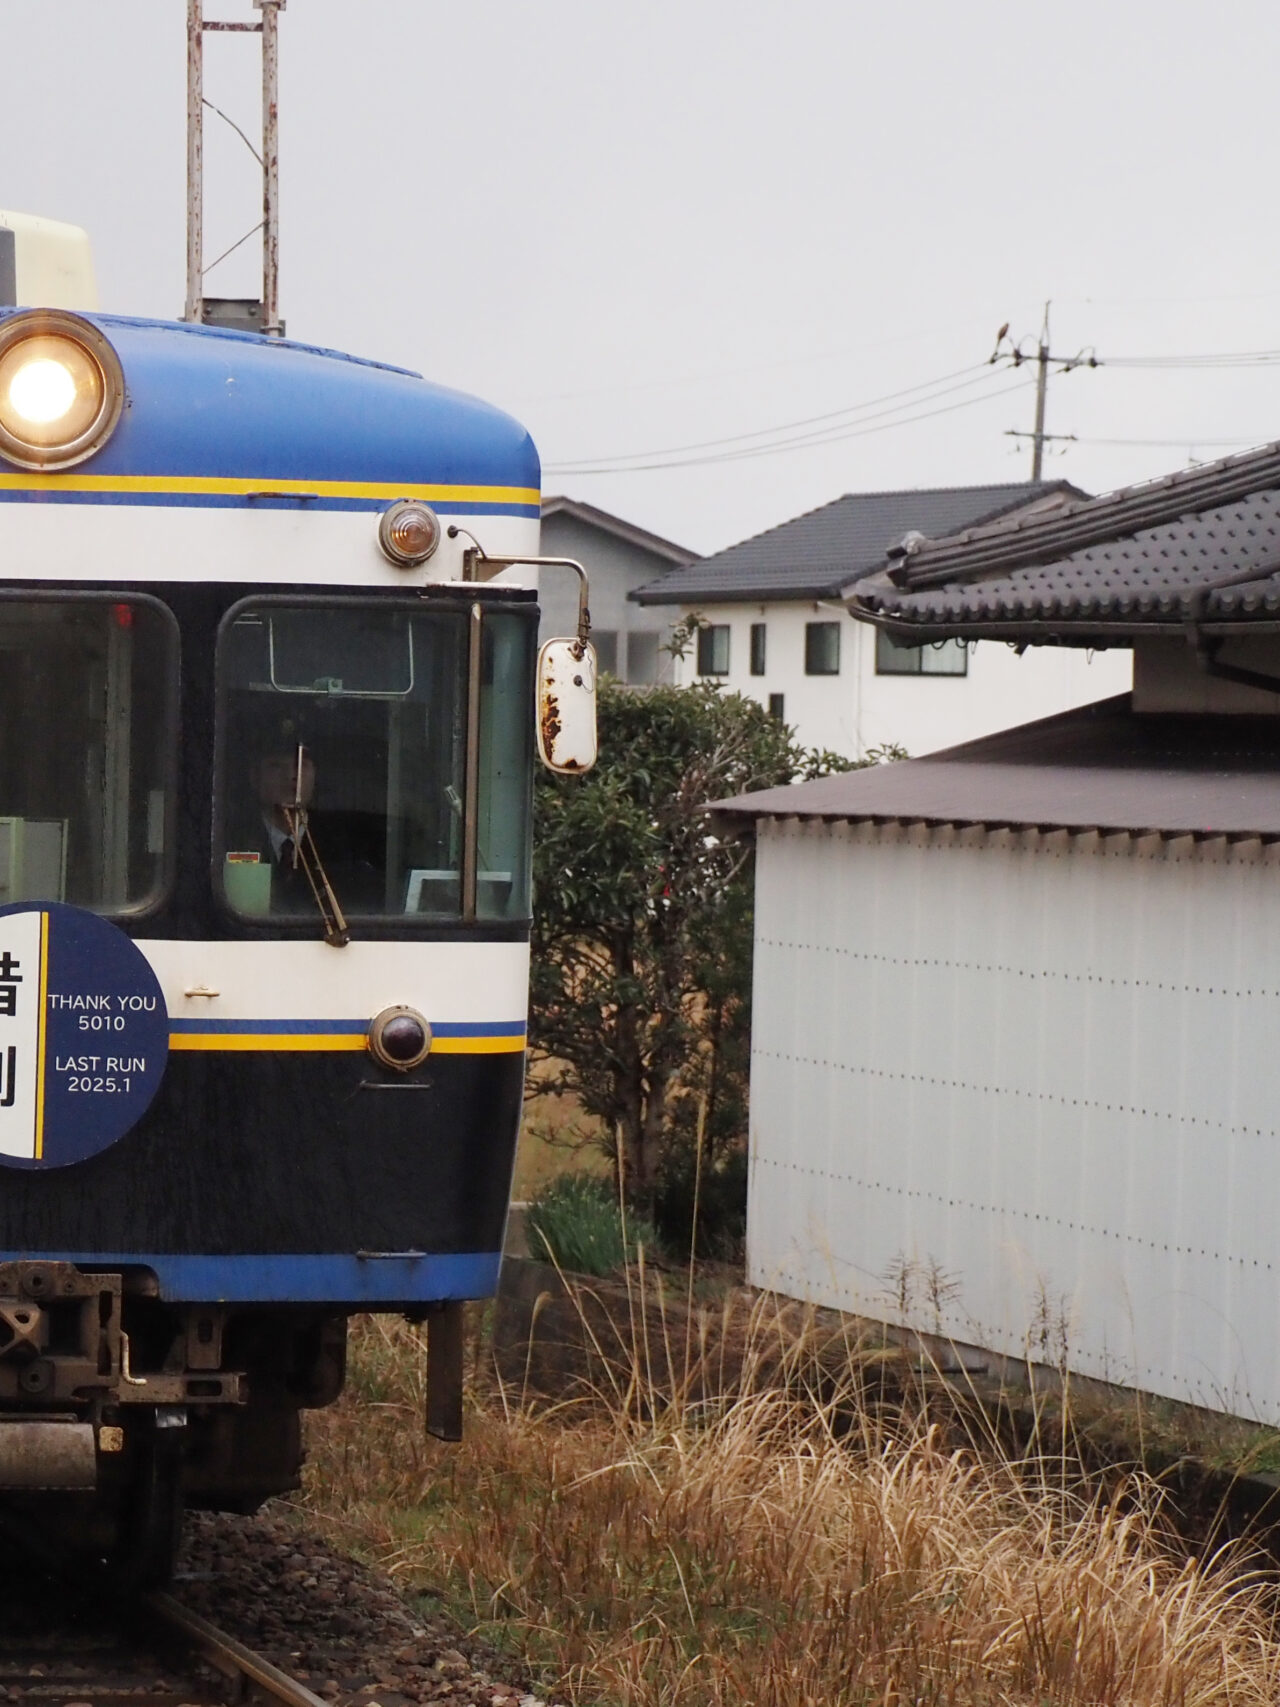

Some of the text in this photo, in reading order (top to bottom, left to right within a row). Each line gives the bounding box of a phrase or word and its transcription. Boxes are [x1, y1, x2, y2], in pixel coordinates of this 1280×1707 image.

[47, 994, 156, 1011] THANK YOU
[78, 1015, 125, 1031] 5010
[55, 1056, 145, 1072] LAST RUN
[68, 1076, 130, 1093] 2025.1
